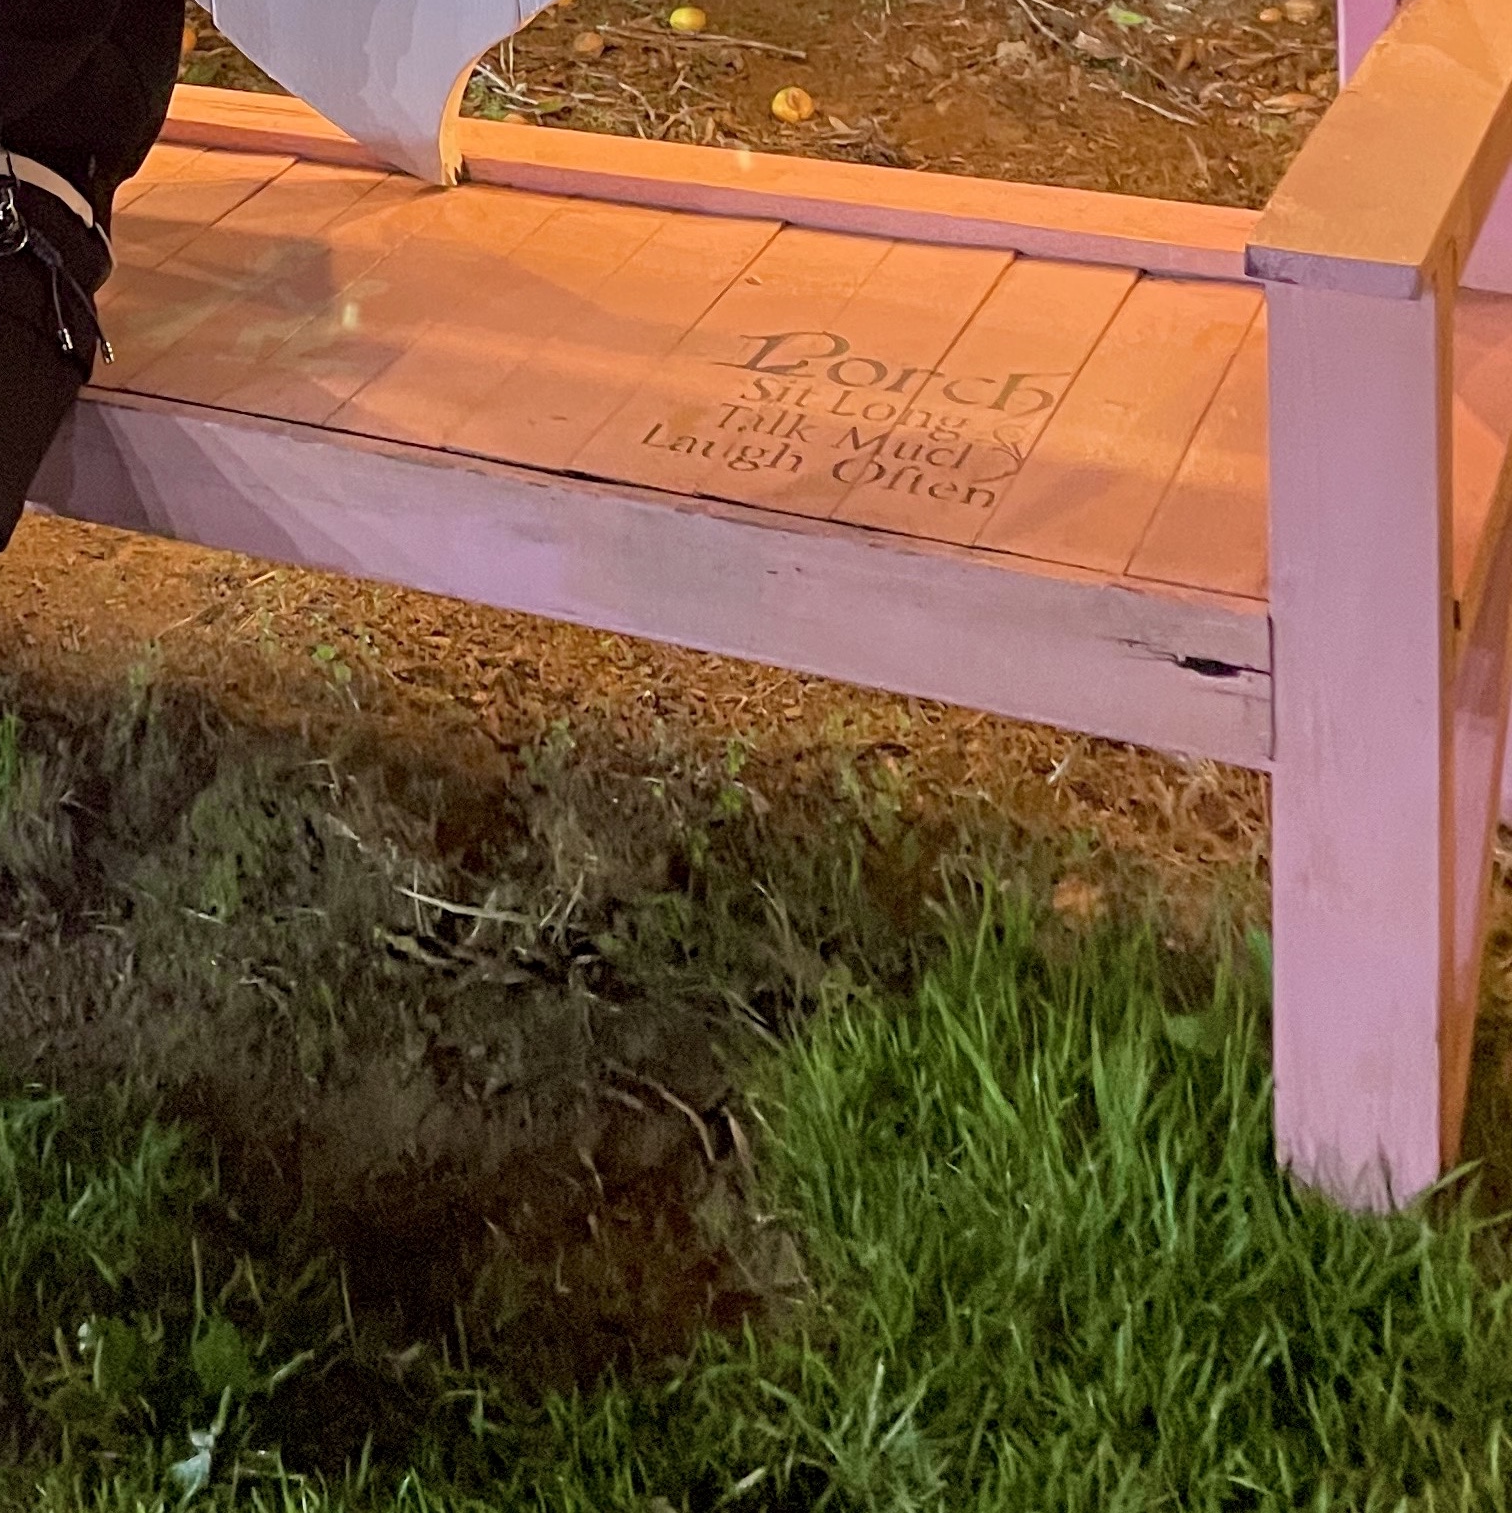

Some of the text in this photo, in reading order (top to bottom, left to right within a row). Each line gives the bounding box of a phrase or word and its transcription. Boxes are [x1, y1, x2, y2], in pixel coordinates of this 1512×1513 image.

[710, 330, 1071, 416] Porch
[739, 377, 970, 441] Sit Long
[641, 423, 804, 473] Laugh
